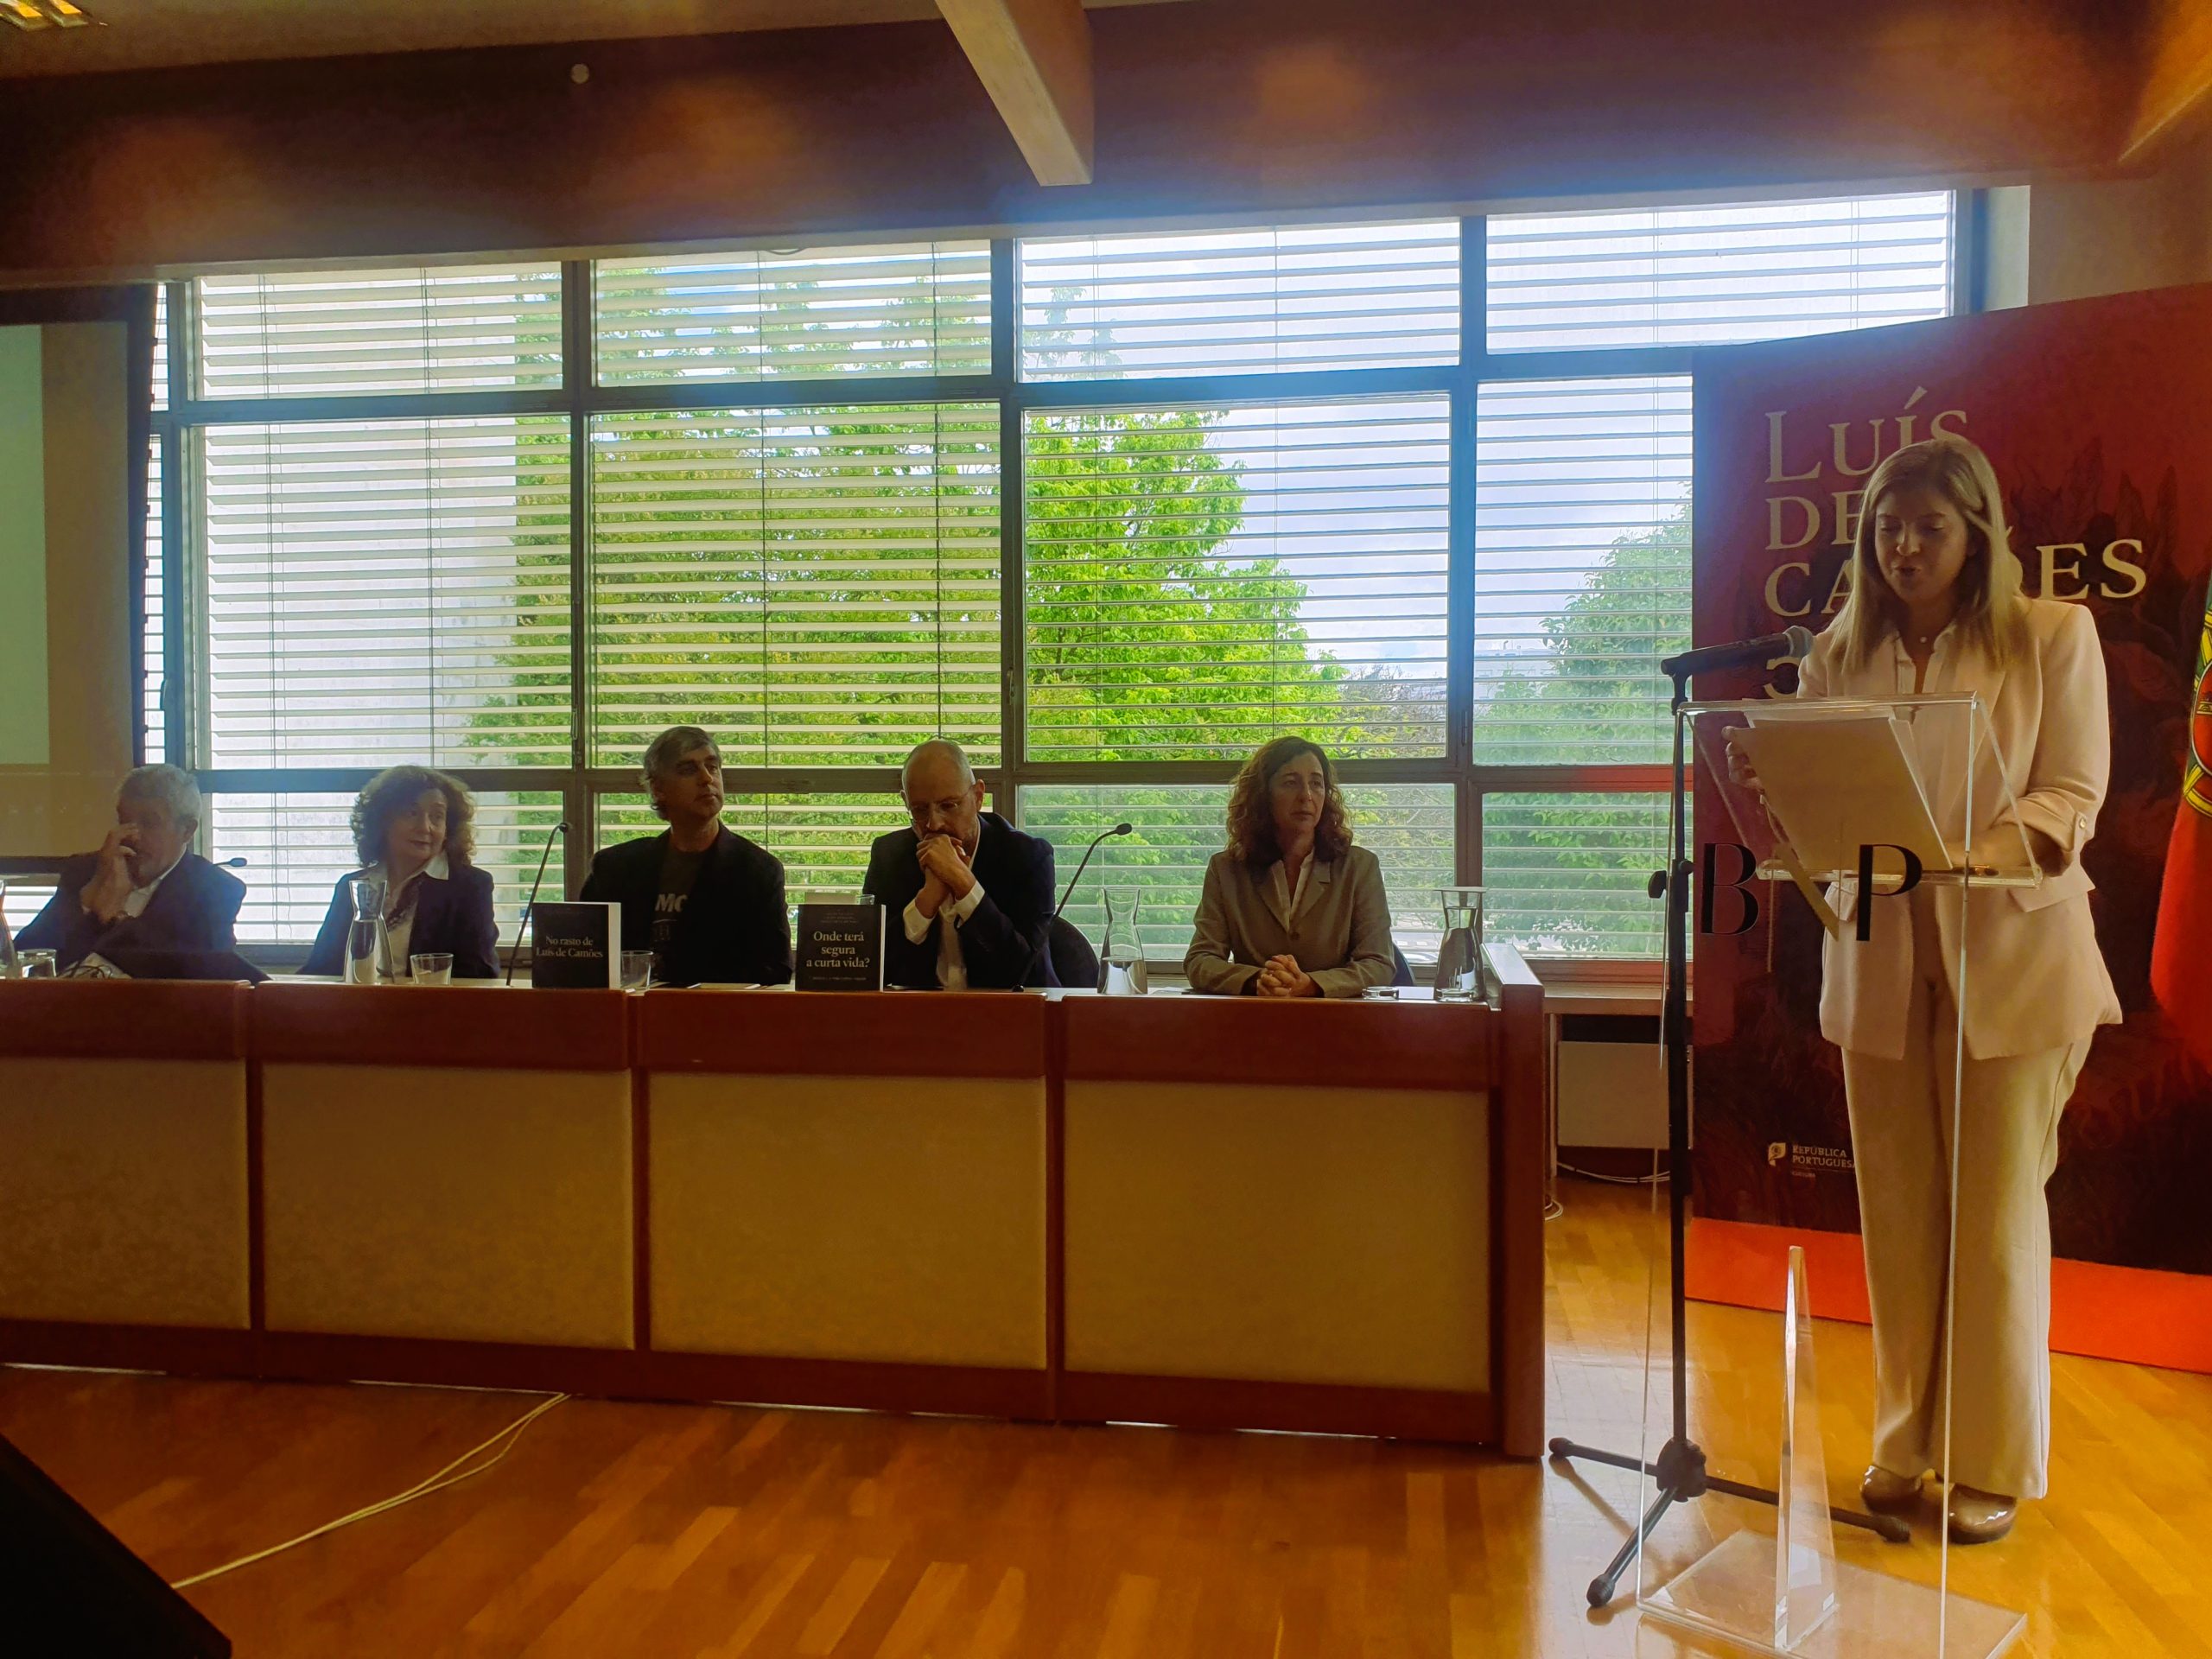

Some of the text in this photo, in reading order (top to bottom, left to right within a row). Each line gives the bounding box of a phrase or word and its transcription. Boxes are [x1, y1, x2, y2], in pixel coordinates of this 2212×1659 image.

[1764, 489, 1866, 550] DE
[1764, 538, 2147, 617] CAES
[545, 936, 594, 946] No rasto de
[813, 931, 865, 942] Onde terá
[556, 948, 567, 957] de
[568, 948, 604, 958] Camões
[821, 946, 855, 957] segura
[806, 957, 870, 968] a curta vida?
